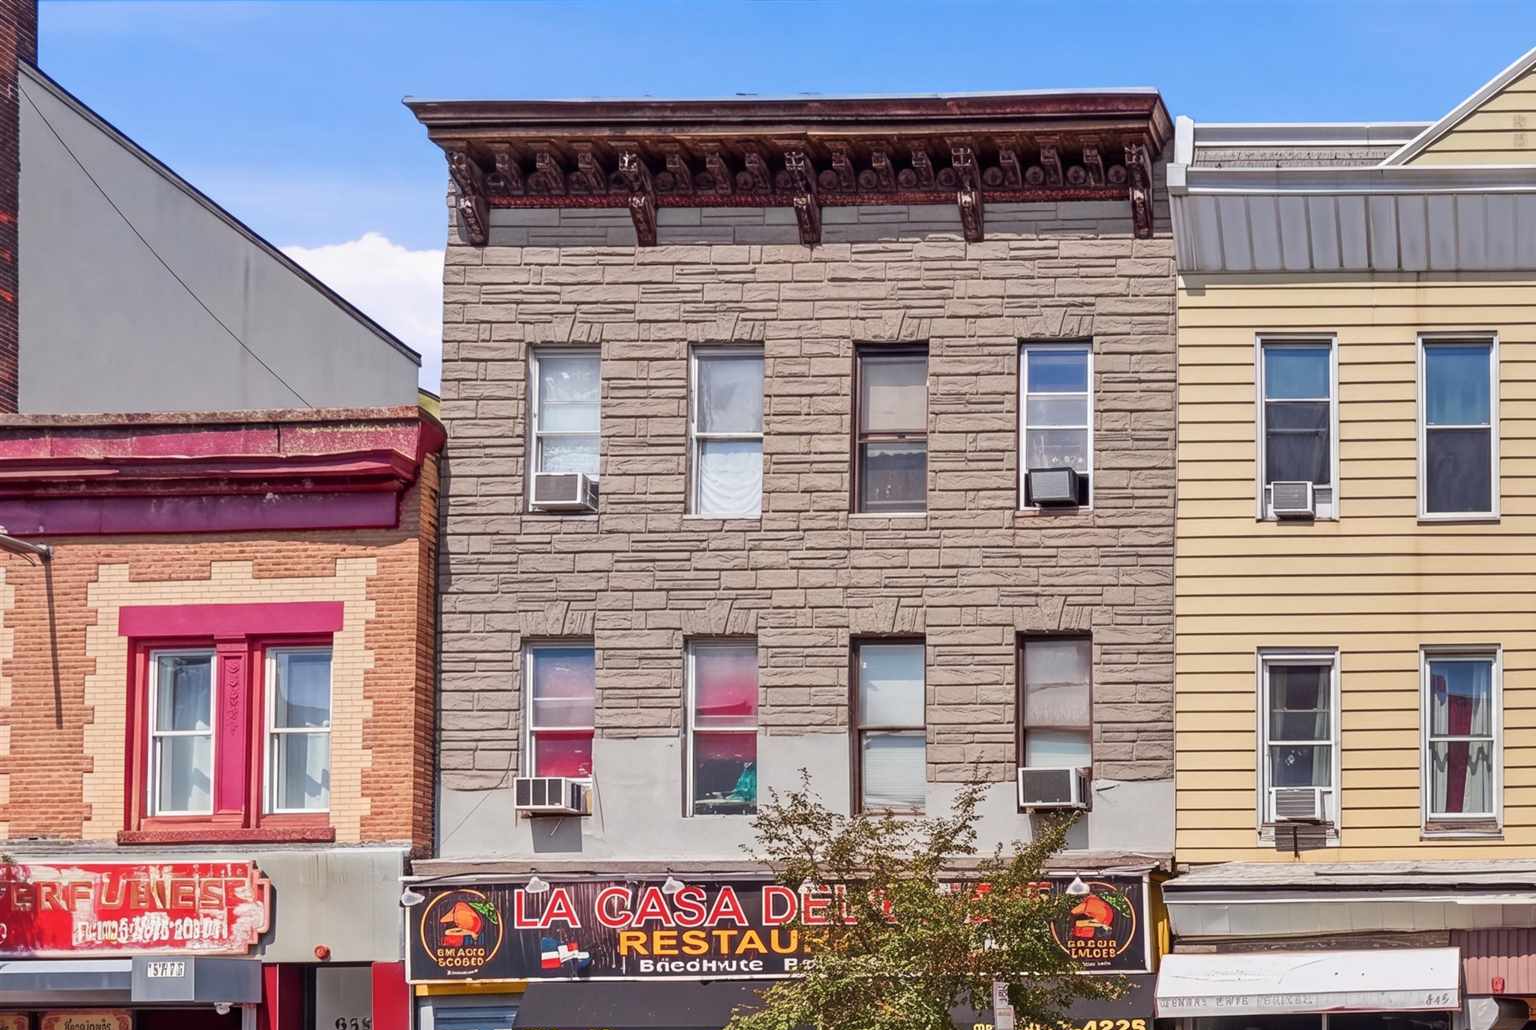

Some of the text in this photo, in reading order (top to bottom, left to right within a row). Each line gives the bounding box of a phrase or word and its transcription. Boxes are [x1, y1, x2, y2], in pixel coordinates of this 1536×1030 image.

[514, 888, 581, 929] LA
[595, 886, 749, 928] CASA
[619, 928, 850, 957] RESTAU
